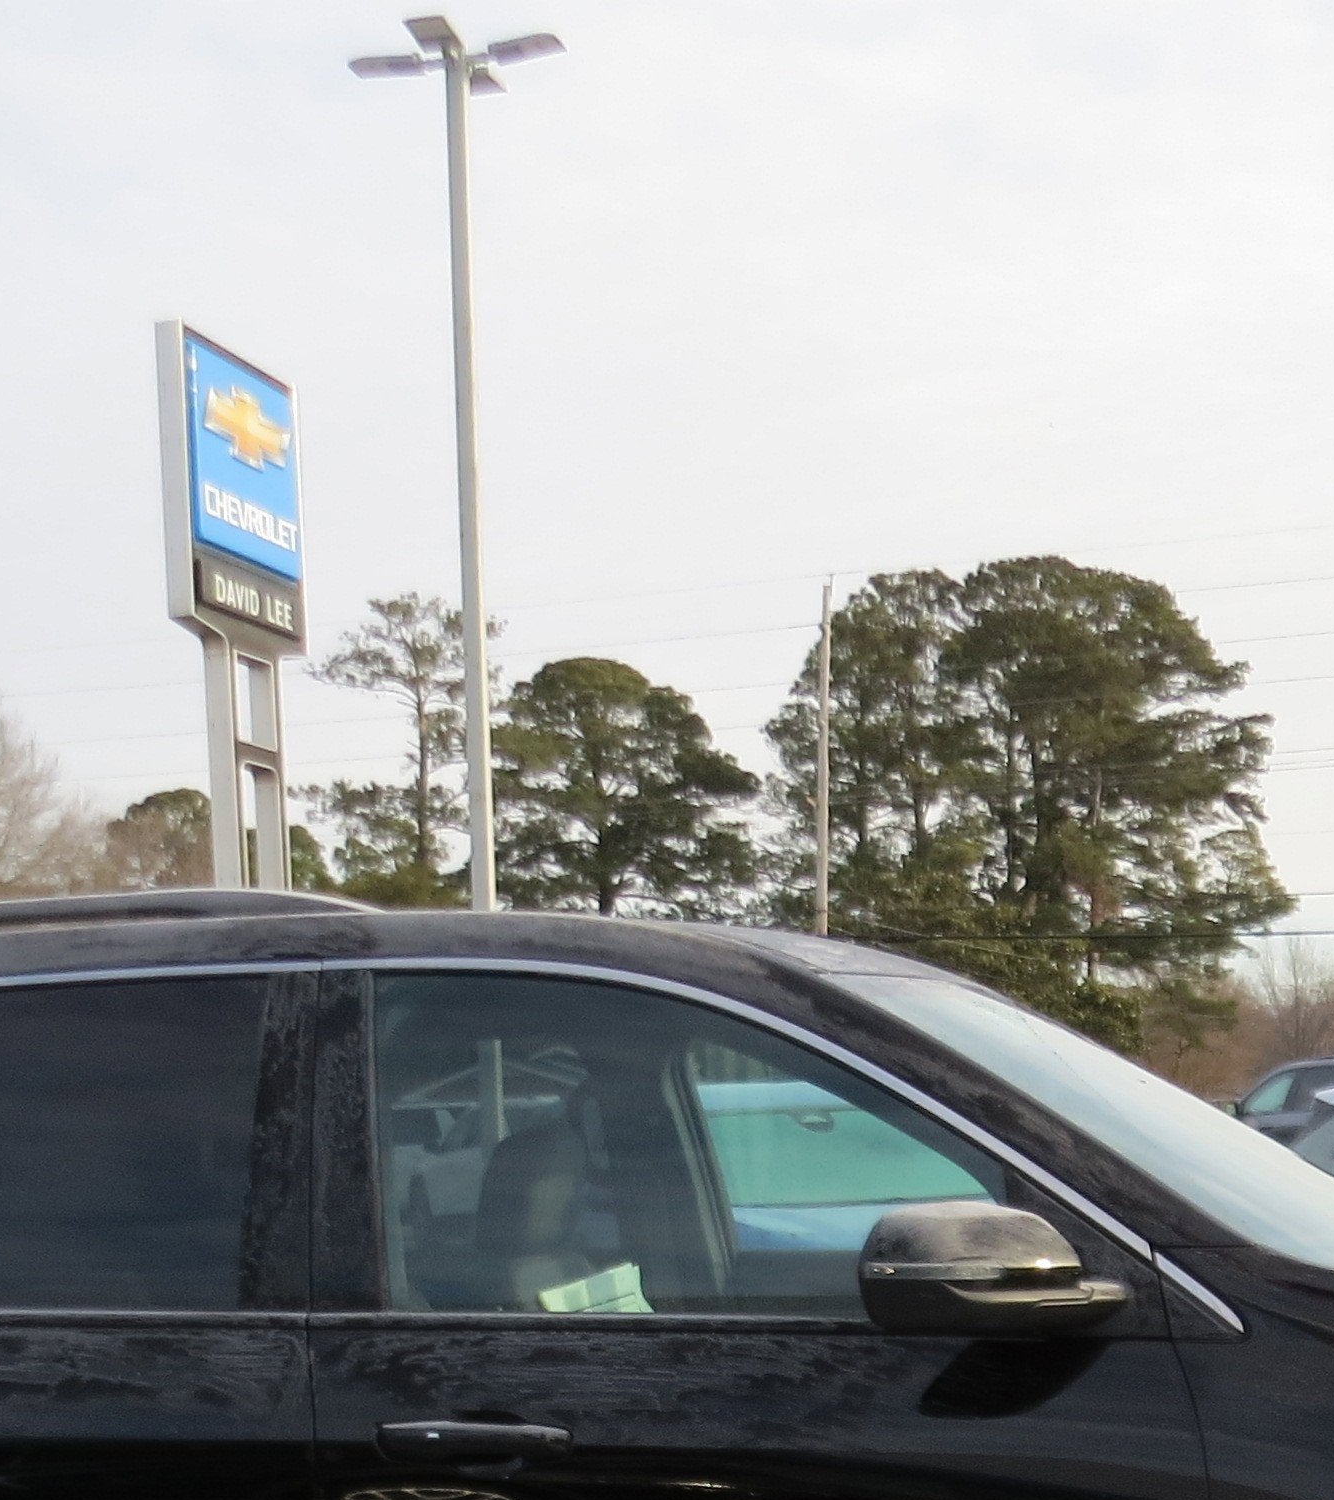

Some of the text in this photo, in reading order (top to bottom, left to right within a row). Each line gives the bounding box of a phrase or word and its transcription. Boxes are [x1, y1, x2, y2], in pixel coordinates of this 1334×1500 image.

[205, 485, 298, 551] CHEVROLET
[216, 574, 294, 631] DAVID LEE
